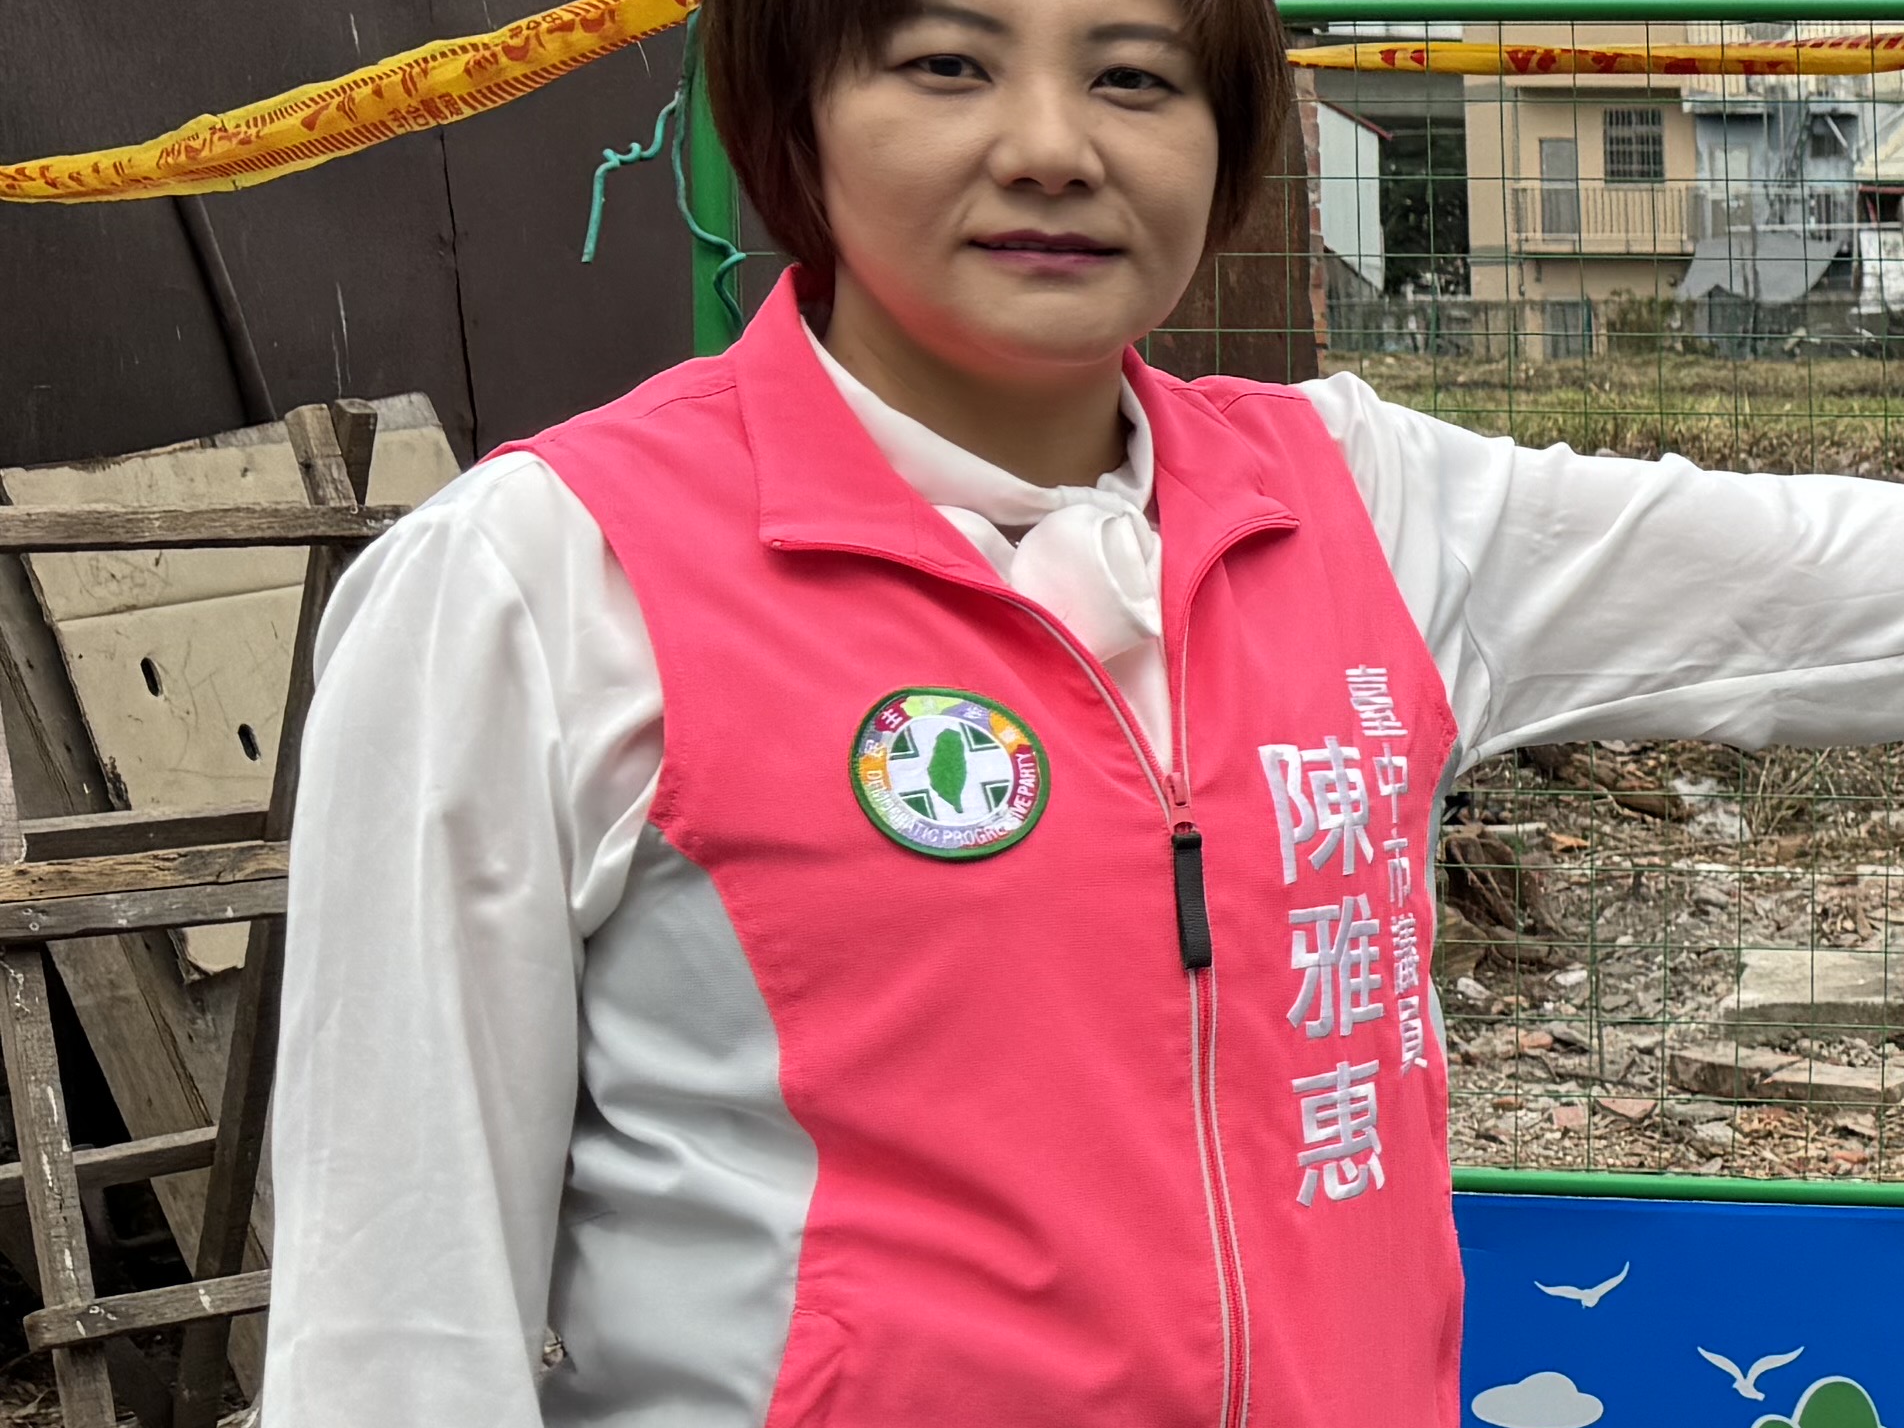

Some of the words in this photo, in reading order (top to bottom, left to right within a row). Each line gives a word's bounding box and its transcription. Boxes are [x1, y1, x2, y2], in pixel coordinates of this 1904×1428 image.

[1014, 752, 1039, 799] PARTY
[1258, 734, 1385, 1209] 陳雅惠
[1345, 664, 1427, 1074] 臺中市議員
